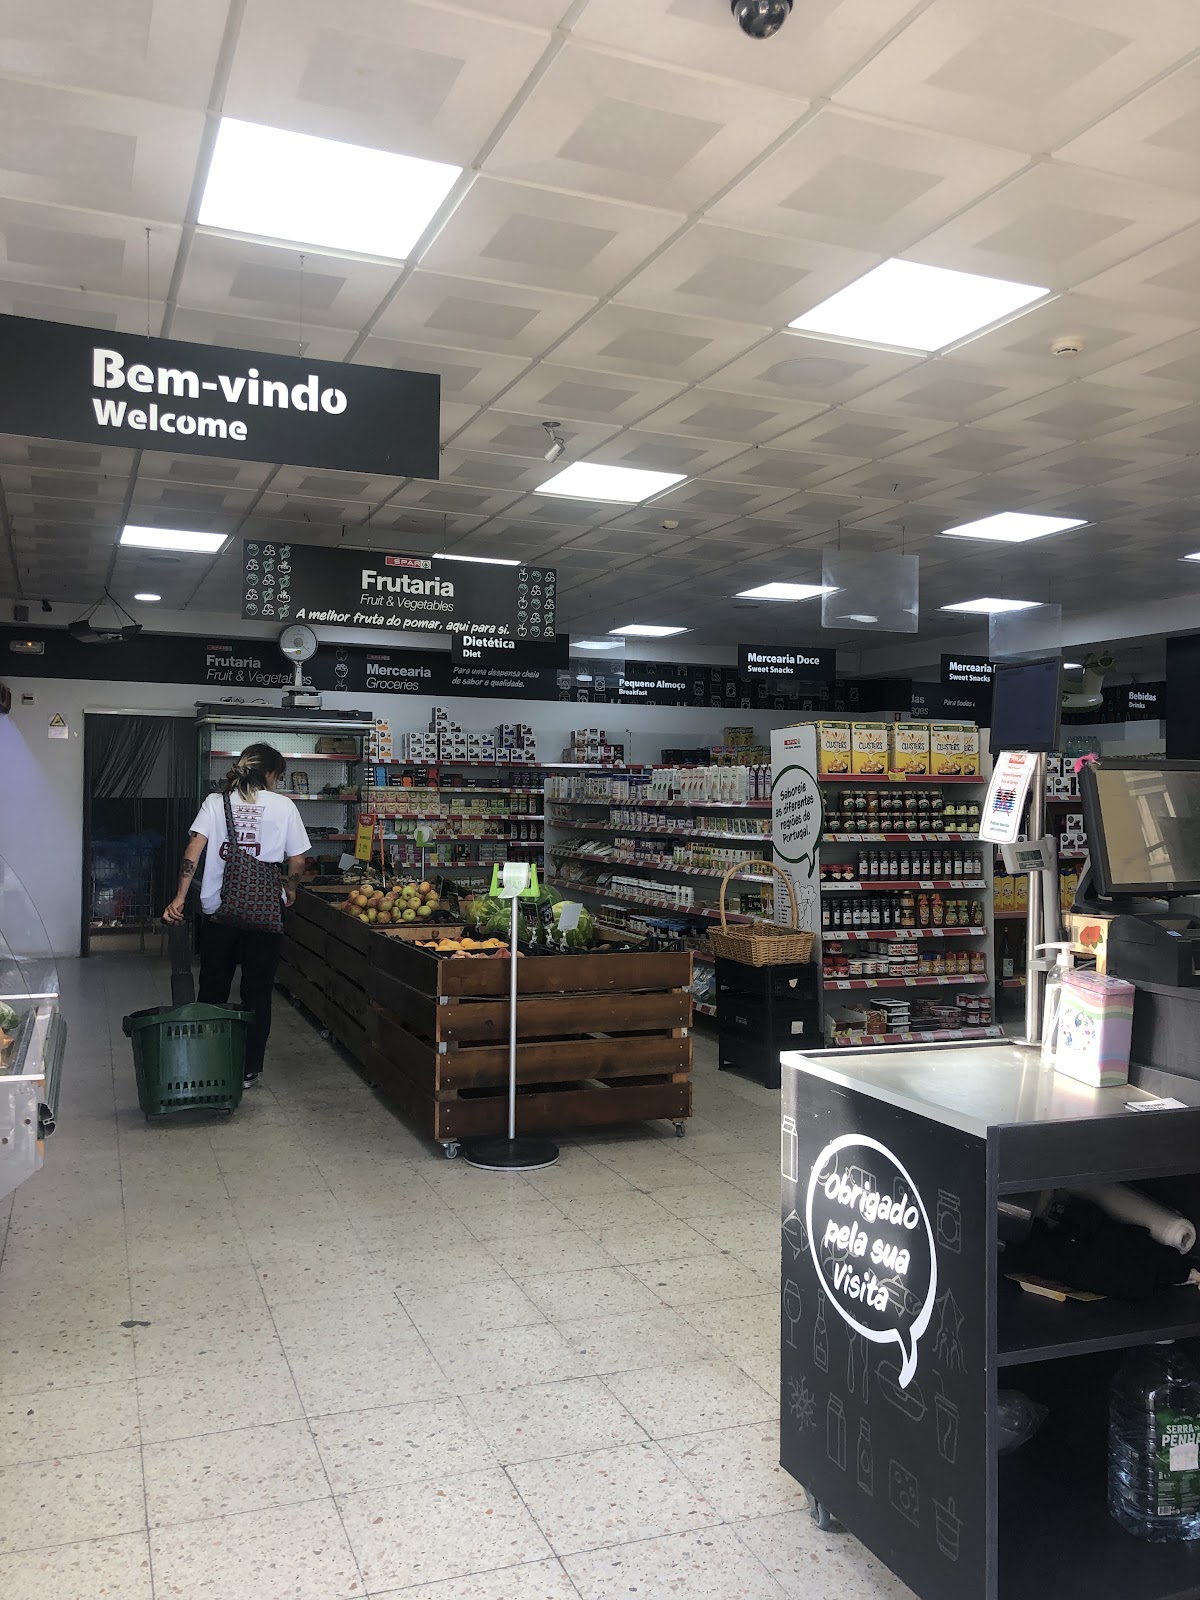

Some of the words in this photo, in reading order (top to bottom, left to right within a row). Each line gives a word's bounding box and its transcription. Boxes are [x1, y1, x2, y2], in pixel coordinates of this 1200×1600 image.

[93, 348, 348, 415] Bem-vindo
[92, 398, 248, 441] Welcome
[393, 558, 421, 567] SPAR
[361, 569, 454, 597] Frutaria
[360, 593, 384, 606] Fruit
[386, 596, 394, 607] &
[397, 596, 455, 612] Vegetables
[295, 608, 306, 619] A
[308, 609, 351, 622] melhor
[353, 612, 384, 625] fruta
[386, 614, 401, 626] do
[403, 618, 443, 630] pomar,
[446, 621, 471, 633] aqui
[470, 623, 496, 634] para
[497, 623, 510, 635] si.
[463, 635, 516, 649] Dietética
[462, 649, 482, 658] Diet
[747, 652, 795, 664] Mercearia
[796, 655, 820, 665] Doce
[206, 654, 261, 669] Frutaria
[949, 661, 992, 673] Mercearia
[206, 669, 233, 681] Fruit
[235, 670, 244, 682] &
[366, 663, 432, 678] Mercearia
[453, 666, 470, 675] Para
[471, 668, 487, 676] uma
[488, 667, 521, 678] despensa
[521, 670, 540, 678] cheia
[747, 664, 769, 673] Sweet
[770, 666, 794, 674] Snacks
[366, 677, 419, 691] Groceries
[451, 677, 461, 685] de
[462, 677, 483, 686] sabor
[490, 679, 525, 688] qualidade.
[618, 678, 655, 689] Pequeno
[656, 680, 686, 691] Almoço
[949, 673, 968, 681] Sweet
[969, 674, 991, 683] Snacks
[618, 688, 648, 696] Breakfast
[1128, 691, 1157, 701] Bebidas
[957, 699, 973, 707] todas
[1128, 701, 1146, 709] Drinks
[826, 741, 847, 749] CLUSTERS
[858, 742, 883, 750] CLUSTERS
[901, 742, 925, 750] CLUSTERS
[936, 743, 960, 751] CLUSTERS
[780, 781, 807, 801] Saboreie
[783, 794, 814, 815] diferentes
[780, 814, 801, 830] regiões
[803, 810, 811, 821] de
[782, 824, 811, 844] Portugal.
[824, 1219, 868, 1257] pela
[871, 1237, 911, 1275] sua
[833, 1262, 889, 1312] Visita
[1166, 1423, 1194, 1434] SERRA
